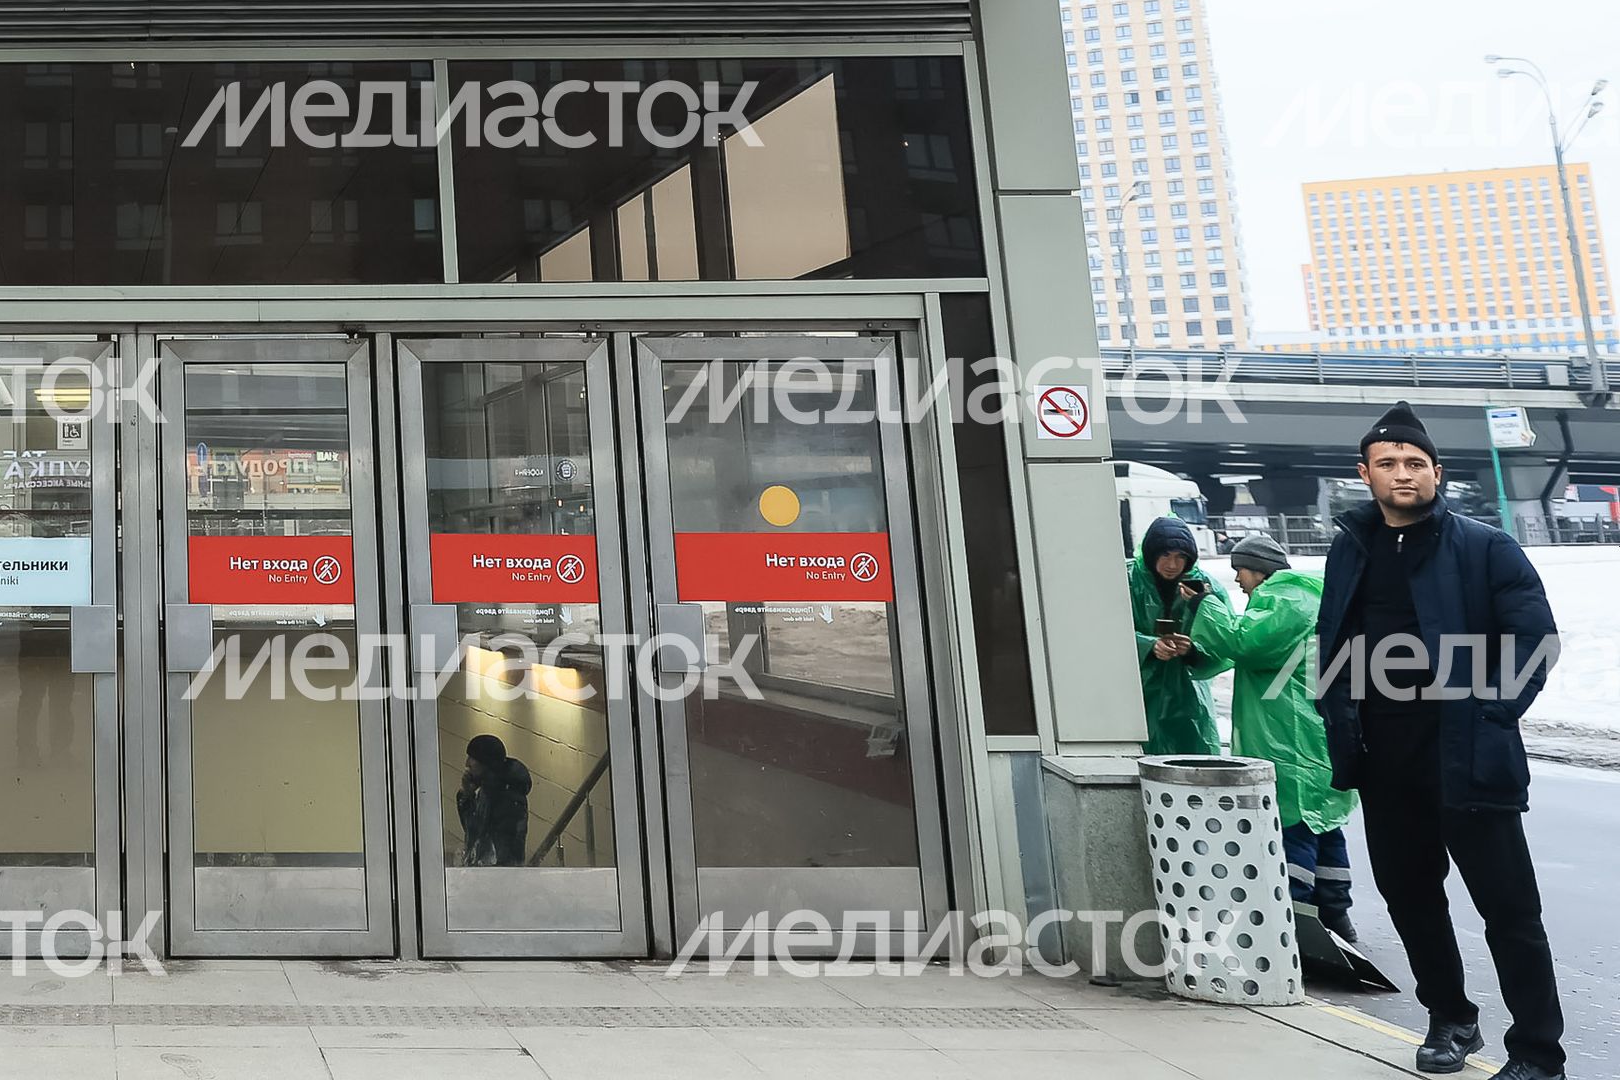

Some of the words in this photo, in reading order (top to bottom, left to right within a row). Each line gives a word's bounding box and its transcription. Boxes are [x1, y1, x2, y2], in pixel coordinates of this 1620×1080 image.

[230, 556, 259, 570] Нет
[262, 559, 309, 572] входа
[472, 555, 502, 568] Нет
[506, 557, 552, 571] входа
[766, 553, 795, 567] Нет
[799, 556, 846, 569] входа
[268, 575, 282, 583] No
[284, 574, 309, 585] Entry
[512, 573, 525, 581] No
[528, 573, 552, 583] Entry
[806, 571, 820, 580] No
[822, 571, 846, 581] Entry
